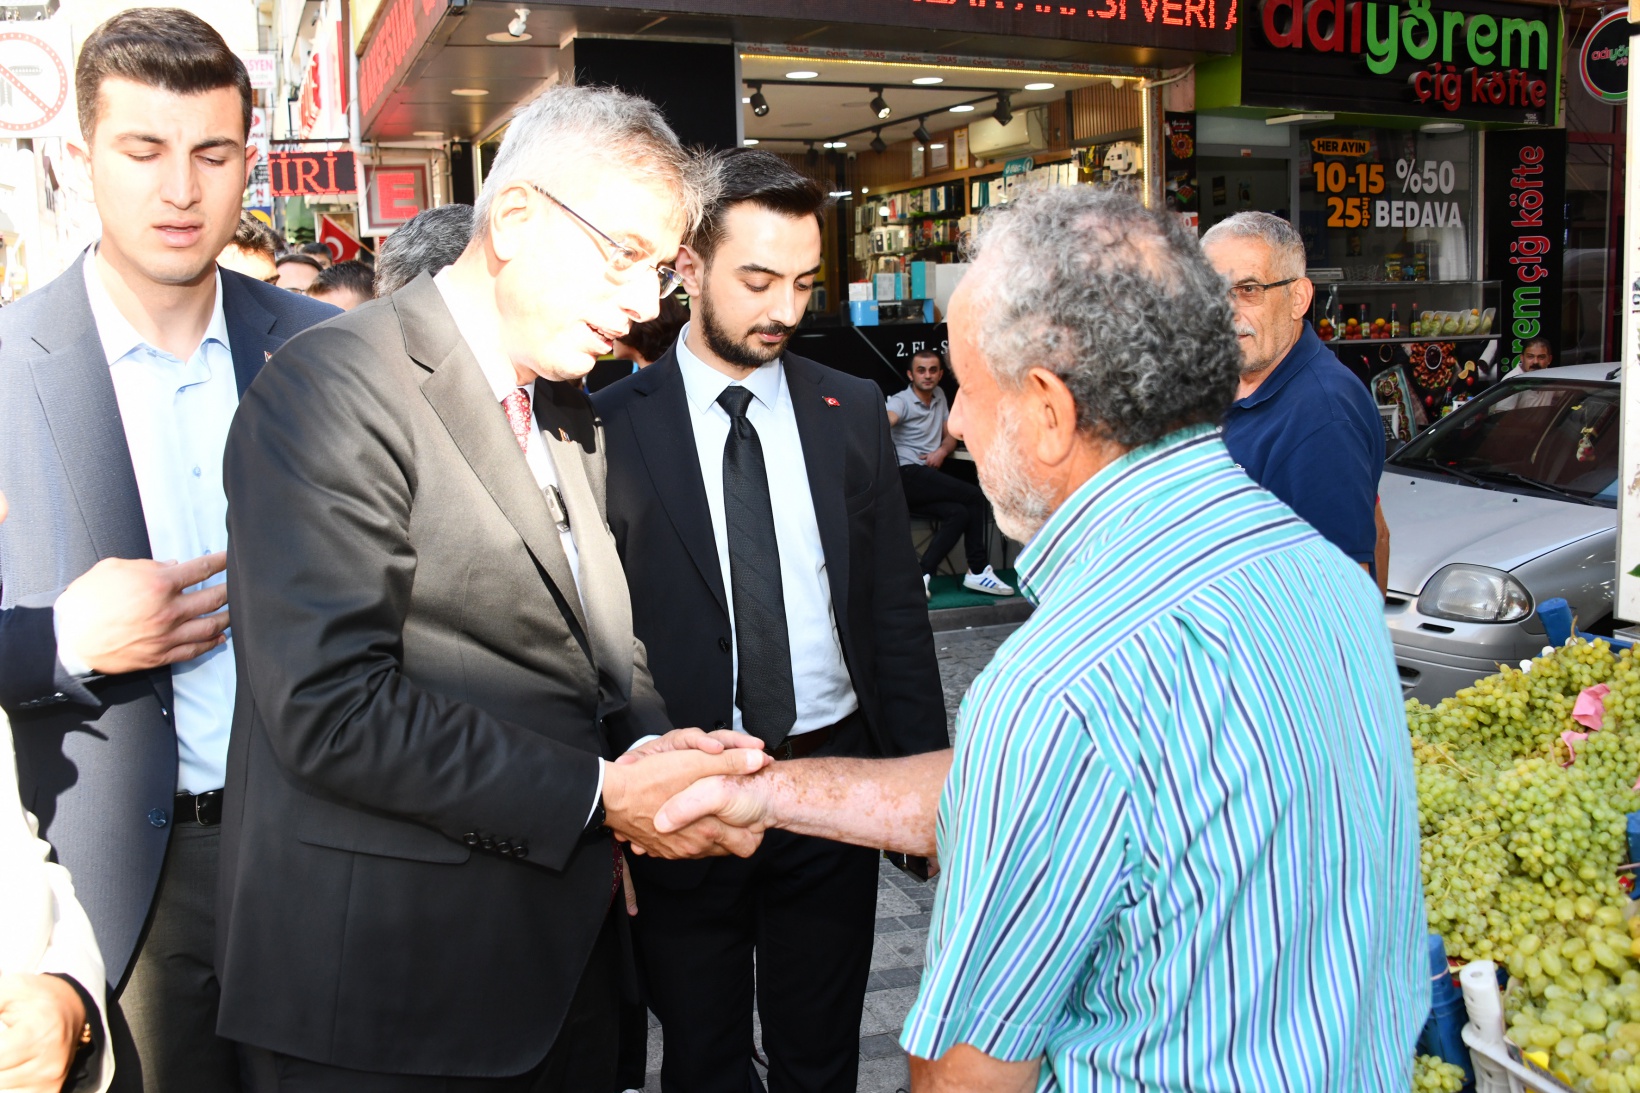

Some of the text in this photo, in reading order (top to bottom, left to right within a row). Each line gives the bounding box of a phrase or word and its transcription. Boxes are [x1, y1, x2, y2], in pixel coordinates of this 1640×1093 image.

[1411, 63, 1547, 111] çiğ köfte
[1317, 140, 1366, 153] HER AYIN
[377, 172, 418, 219] E
[1313, 158, 1455, 194] 10-15 %50
[1509, 146, 1545, 227] köfte
[1327, 197, 1362, 228] 25
[1375, 200, 1462, 228] BEDAVA
[1509, 235, 1550, 283] çiğ
[896, 342, 909, 357] 2.
